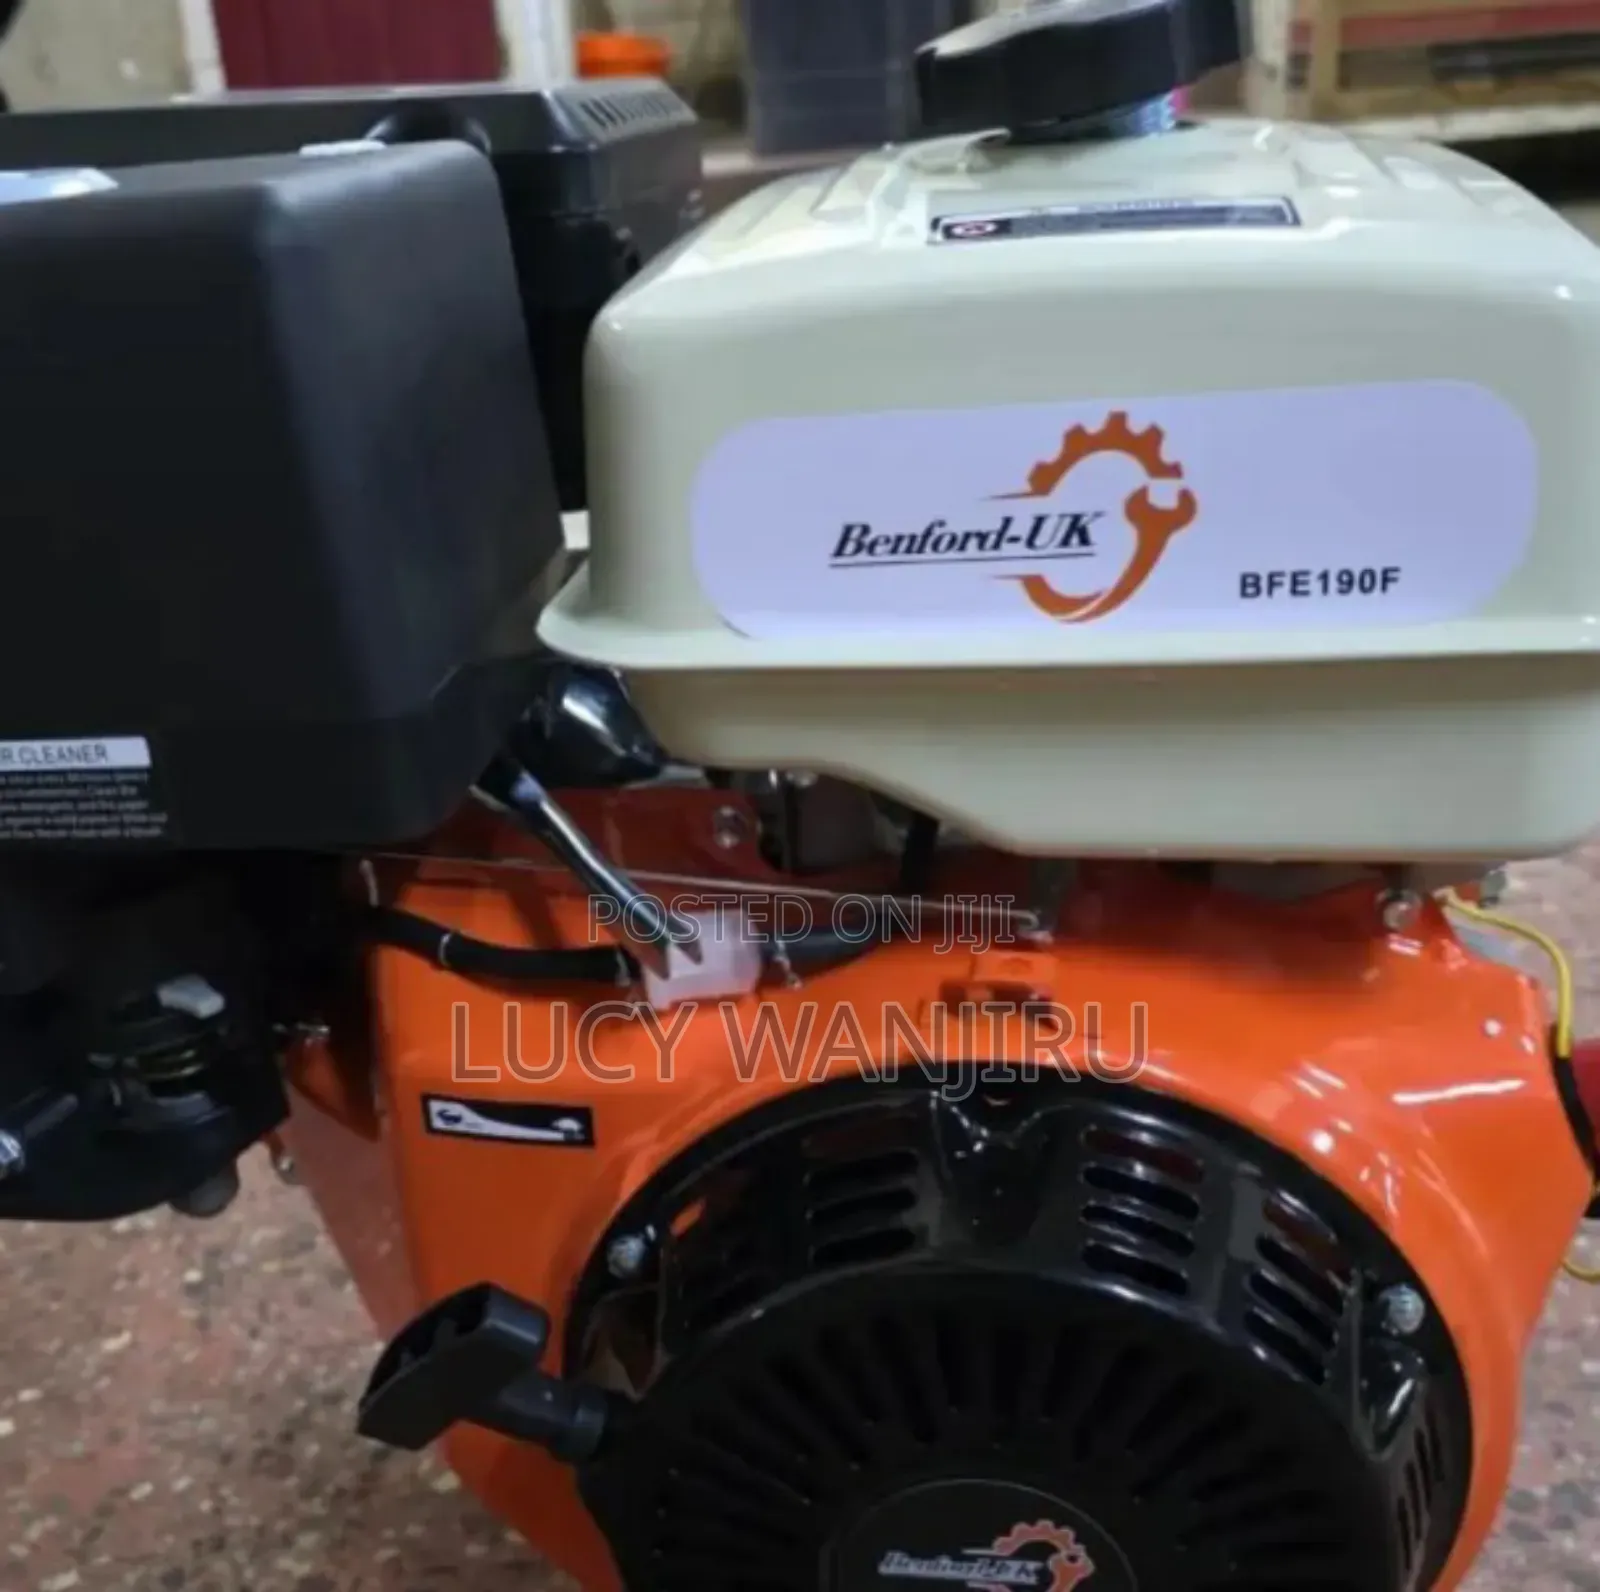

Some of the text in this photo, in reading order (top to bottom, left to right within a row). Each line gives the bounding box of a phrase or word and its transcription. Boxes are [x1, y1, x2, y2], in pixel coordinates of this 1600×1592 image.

[829, 511, 1106, 559] Benford-UK
[1239, 566, 1401, 599] BFE190F
[19, 744, 108, 764] CLEANER
